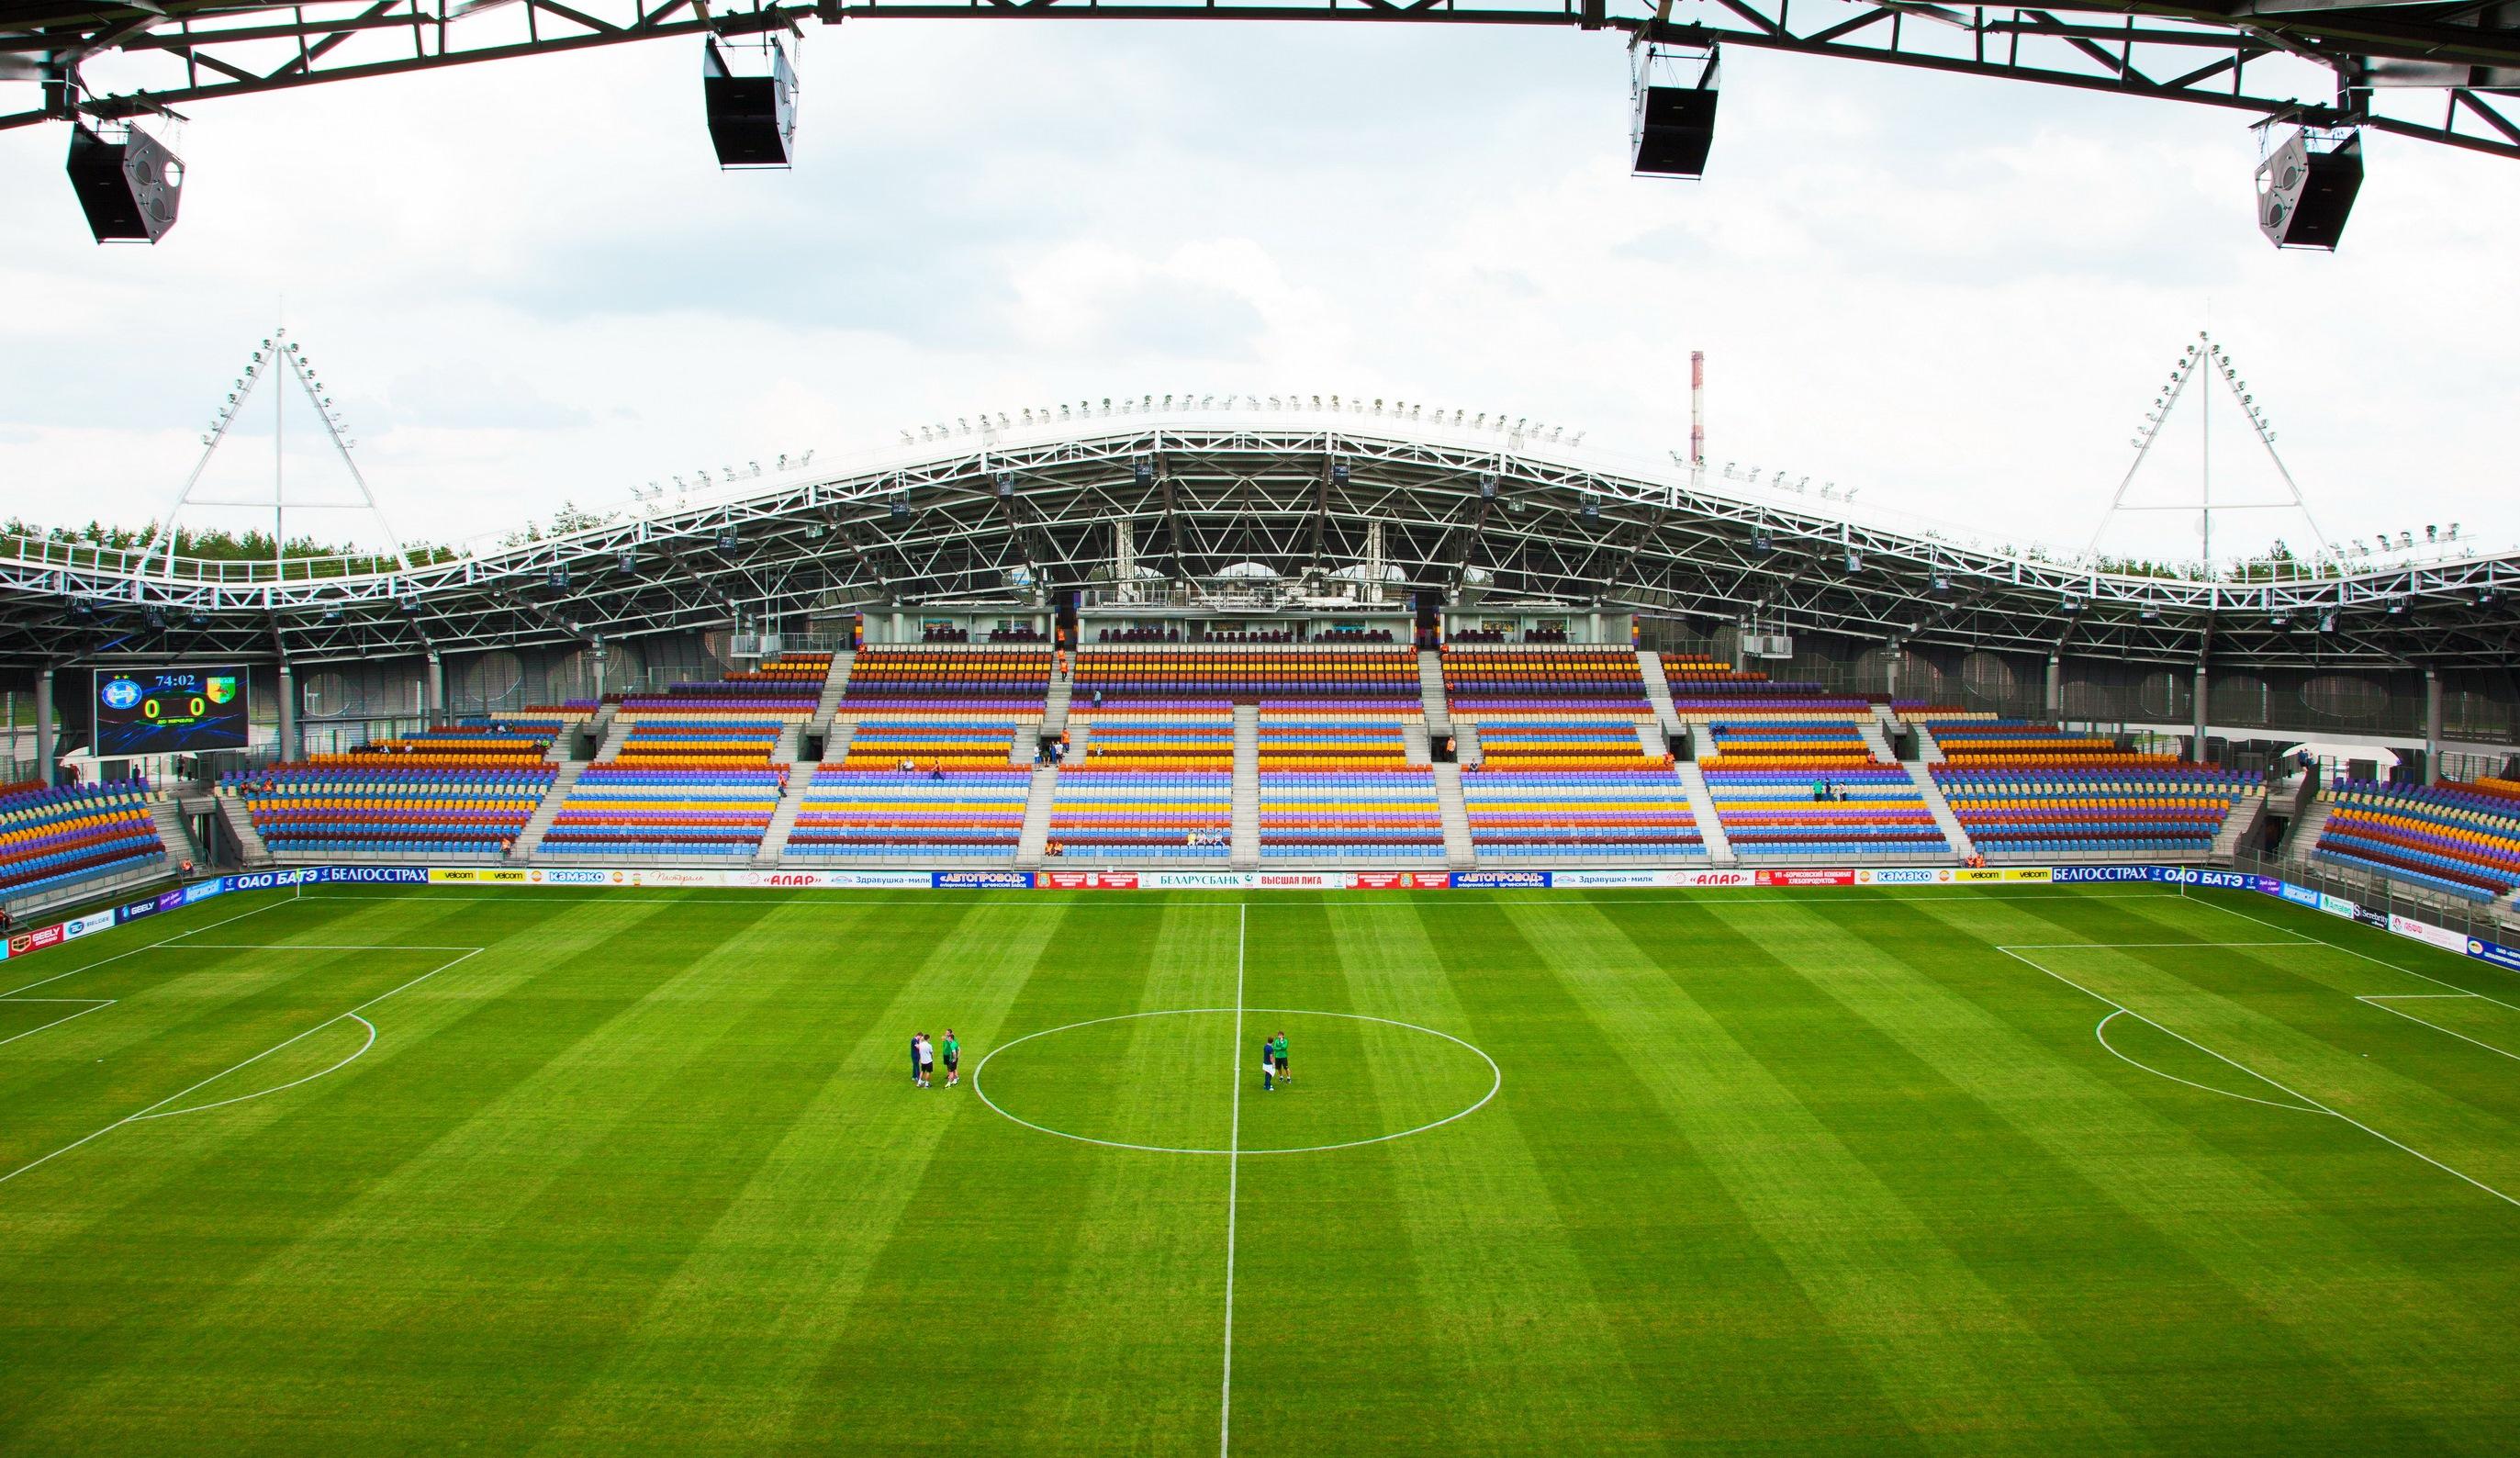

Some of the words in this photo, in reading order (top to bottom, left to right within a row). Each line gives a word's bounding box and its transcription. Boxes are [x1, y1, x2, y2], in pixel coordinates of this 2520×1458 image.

[155, 675, 196, 687] 74:02
[144, 699, 161, 719] 0
[190, 697, 206, 716] 0
[238, 875, 273, 889] ОАО
[276, 869, 318, 885] БАТЭ
[331, 868, 428, 881] БЕЛГОССТРАХ
[445, 871, 474, 880] velcom
[494, 871, 523, 880] velcom
[939, 873, 1026, 883] «АВТОПРОВОД»
[1457, 872, 1544, 883] «АВТОПРОВОД»
[2020, 870, 2048, 879] velcom
[2053, 867, 2148, 880] БЕЛГОССТРАХ
[2165, 869, 2197, 882] ОАО
[2201, 872, 2244, 887] БАТЭ
[764, 875, 822, 886] «АЛАР»
[856, 875, 931, 886] Здравушка-милк
[1160, 875, 1239, 885] БЕЛАРУСБАНК
[1261, 876, 1299, 885] ВЫСШАЯ
[1302, 876, 1322, 885] ЛИГА
[1579, 875, 1653, 885] Здравушка-милк
[1690, 874, 1748, 885] «АЛАР»
[131, 902, 155, 915] GEELY
[33, 926, 61, 942] GEELY
